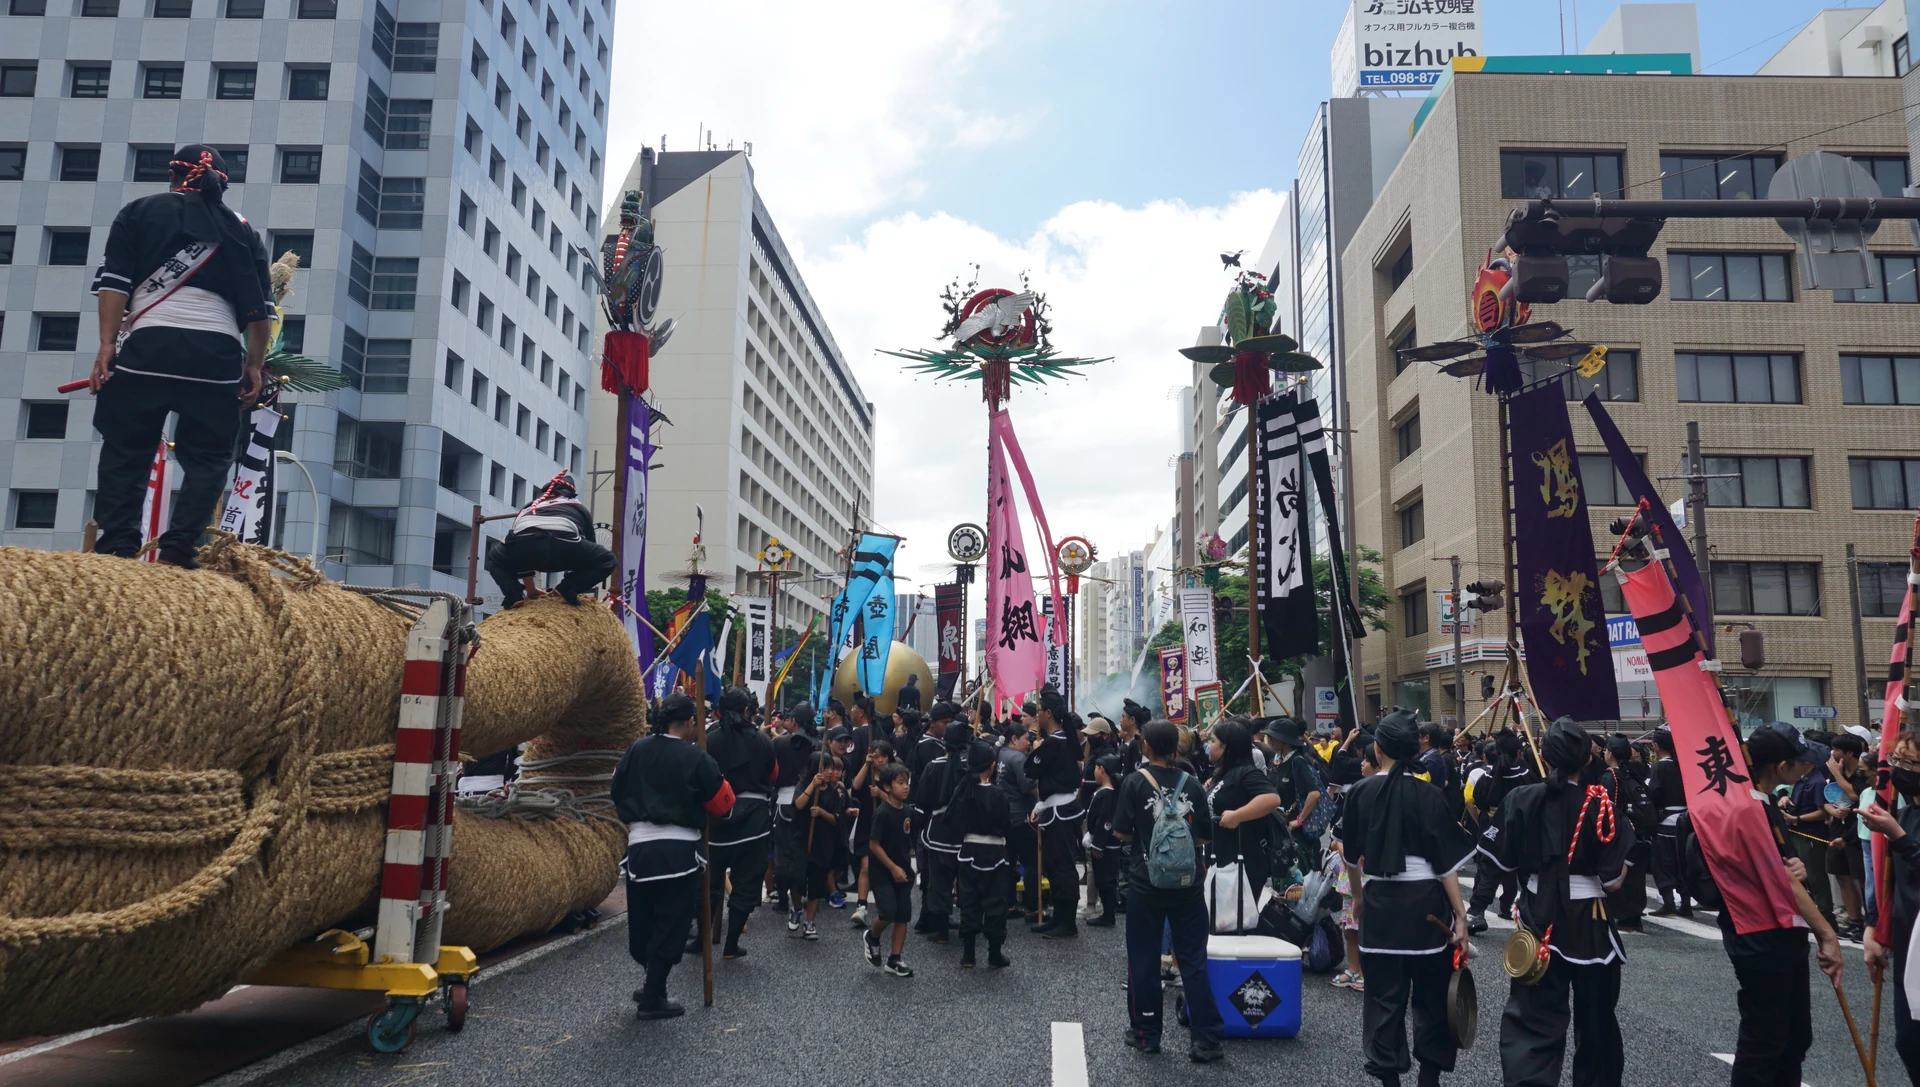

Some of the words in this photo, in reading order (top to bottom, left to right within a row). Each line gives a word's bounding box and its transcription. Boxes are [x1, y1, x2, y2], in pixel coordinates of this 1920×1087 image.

[1366, 72, 1442, 84] TEL.098-87
[942, 619, 959, 662] 泉
[1695, 735, 1751, 797] 東
